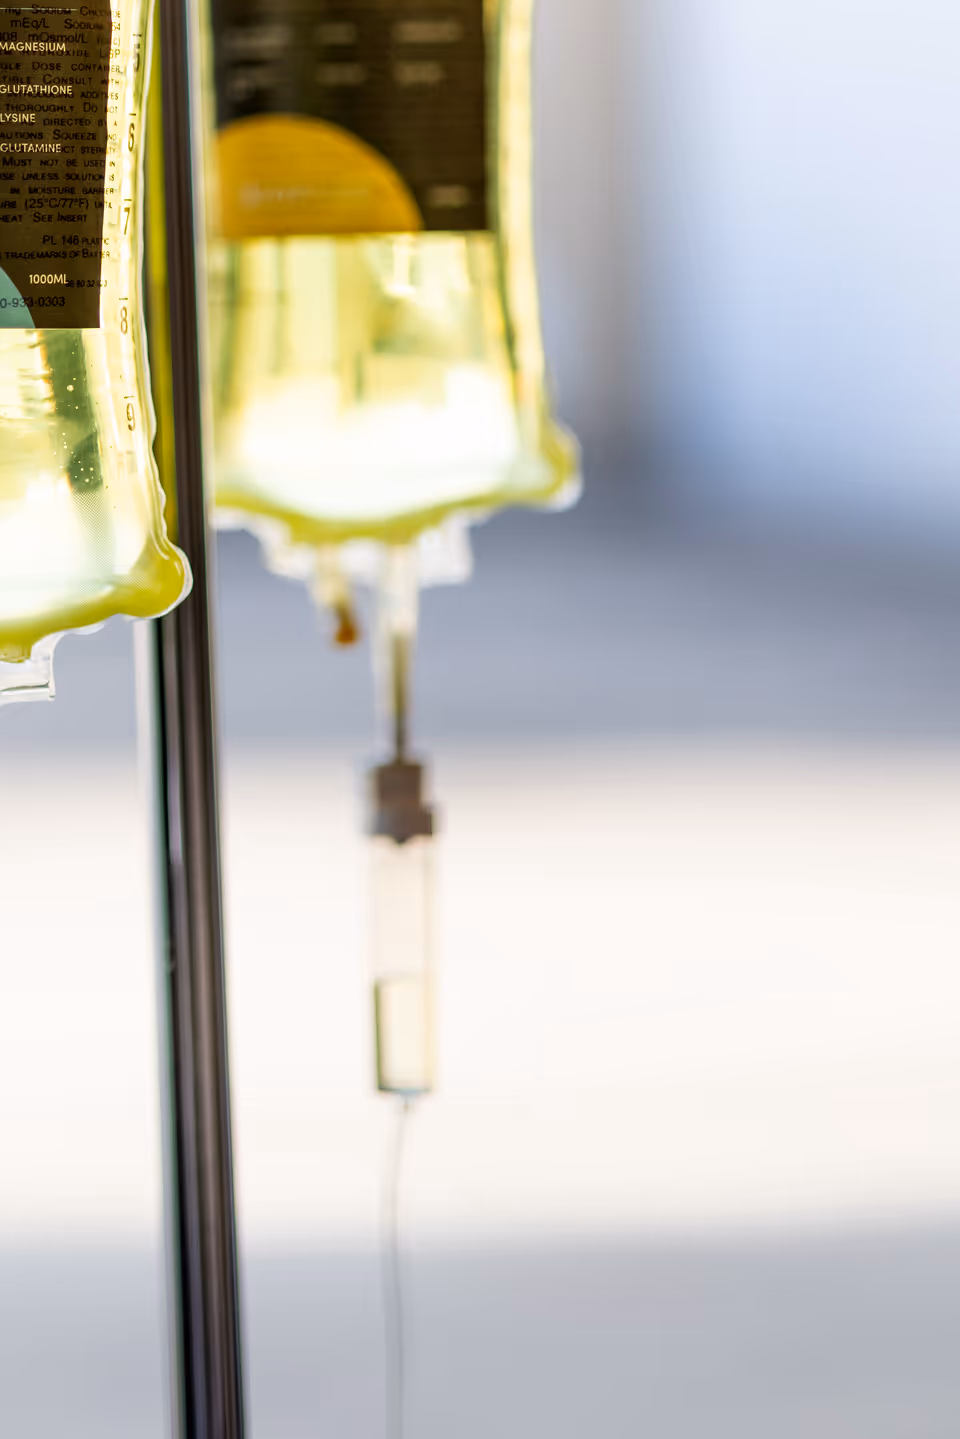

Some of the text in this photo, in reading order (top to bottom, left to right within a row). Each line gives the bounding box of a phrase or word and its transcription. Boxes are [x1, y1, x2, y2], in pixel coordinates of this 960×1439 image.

[0, 113, 36, 123] LYSINE
[0, 142, 62, 153] GLUTAMINE
[28, 273, 69, 285] 1000ML
